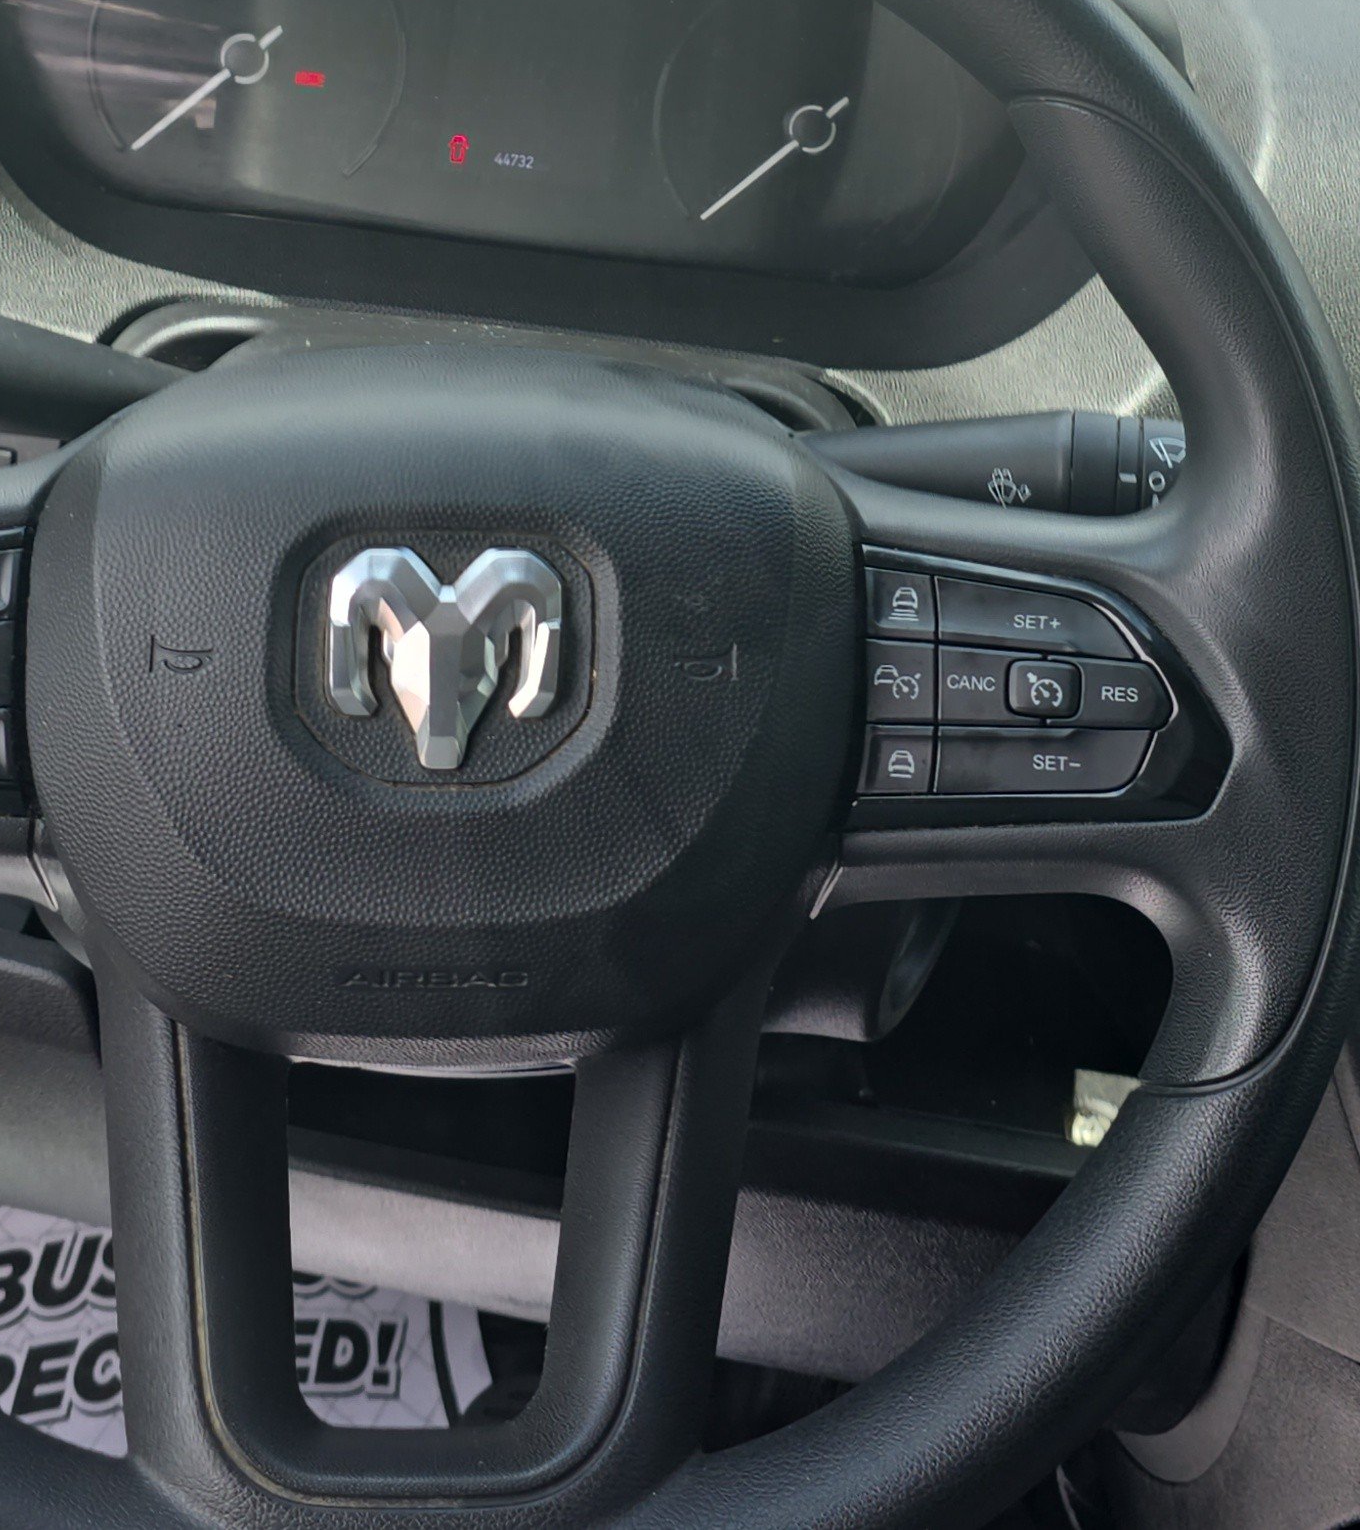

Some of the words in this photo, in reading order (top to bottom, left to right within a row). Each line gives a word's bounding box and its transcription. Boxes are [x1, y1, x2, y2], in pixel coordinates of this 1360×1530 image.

[494, 153, 534, 169] 44732
[1013, 614, 1061, 630] SET+
[946, 675, 996, 692] CANC
[1101, 686, 1139, 703] RES
[337, 971, 528, 988] AIRBAG
